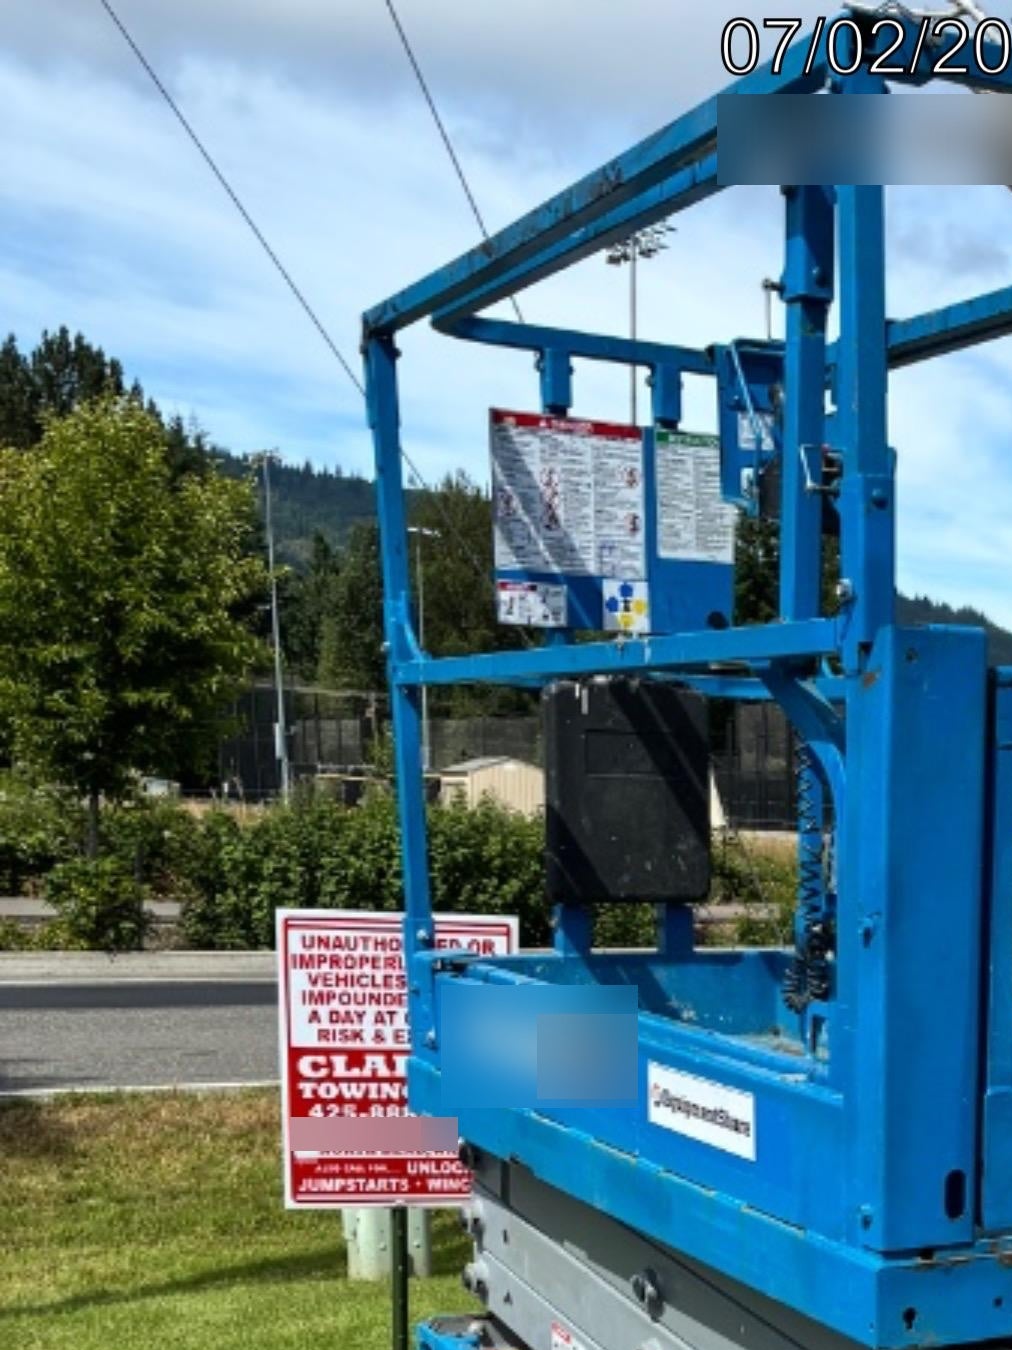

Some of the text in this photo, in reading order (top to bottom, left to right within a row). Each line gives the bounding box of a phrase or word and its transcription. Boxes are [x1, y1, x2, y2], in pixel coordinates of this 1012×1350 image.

[301, 935, 496, 955] UNAUTHOED OR
[308, 973, 407, 989] VEHICLES
[302, 990, 408, 1006] IMPOUNDE
[308, 1010, 321, 1024] A
[329, 1010, 366, 1025] DAY
[374, 1011, 397, 1025] AT
[317, 1028, 365, 1043] RISK
[372, 1030, 385, 1044] &
[299, 1177, 409, 1192] JUMPSTARTS
